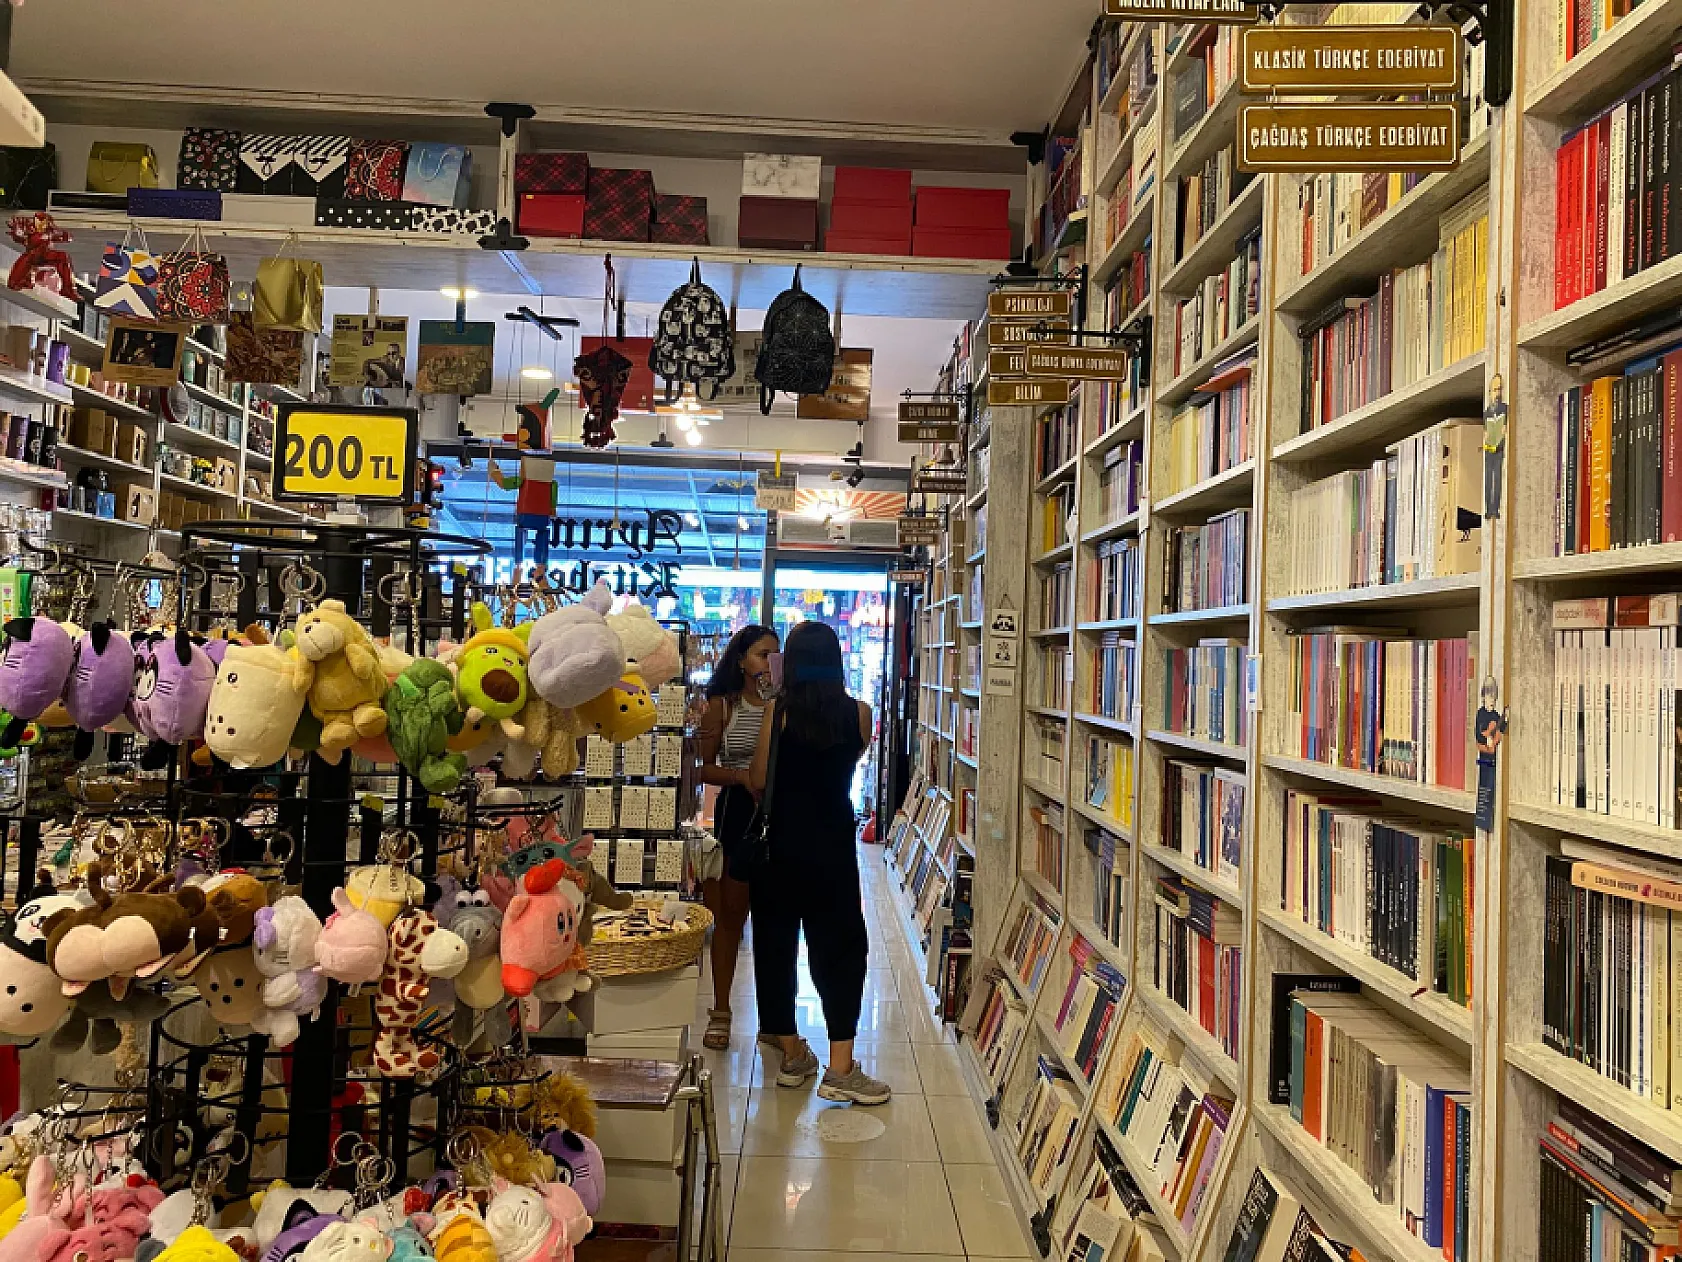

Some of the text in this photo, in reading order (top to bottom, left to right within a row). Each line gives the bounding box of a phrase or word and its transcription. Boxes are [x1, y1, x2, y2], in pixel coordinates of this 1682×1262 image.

[1253, 47, 1446, 72] KLASİK TÜRKÇE EDEBİYAT
[1250, 123, 1448, 149] ÇAĞDAŞ TÜRKÇE EDEBİYAT
[285, 434, 399, 482] 200 TL
